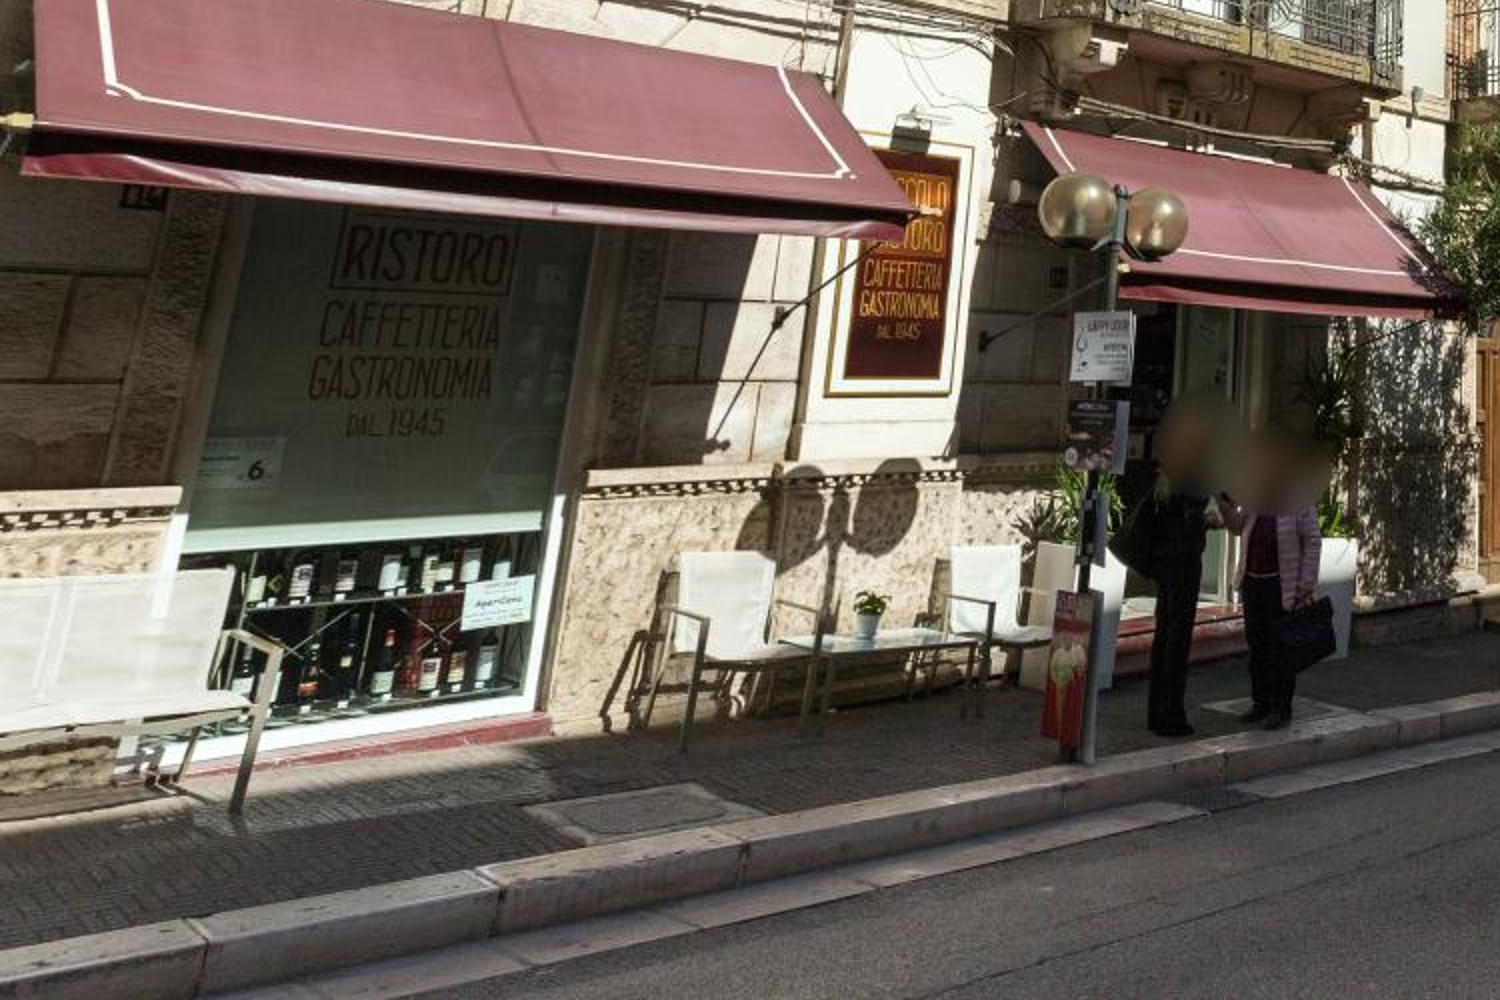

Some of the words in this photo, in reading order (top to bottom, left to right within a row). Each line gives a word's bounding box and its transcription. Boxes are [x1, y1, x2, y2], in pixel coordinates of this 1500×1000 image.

[342, 224, 510, 286] RISTORO
[863, 258, 943, 291] CAFFETTERIA
[859, 289, 940, 320] GASTRONOMIA
[319, 299, 499, 349] CAFFETTERIA
[896, 321, 921, 341] 1945
[307, 354, 492, 400] GASTRONOMIA
[388, 408, 446, 437] 1945
